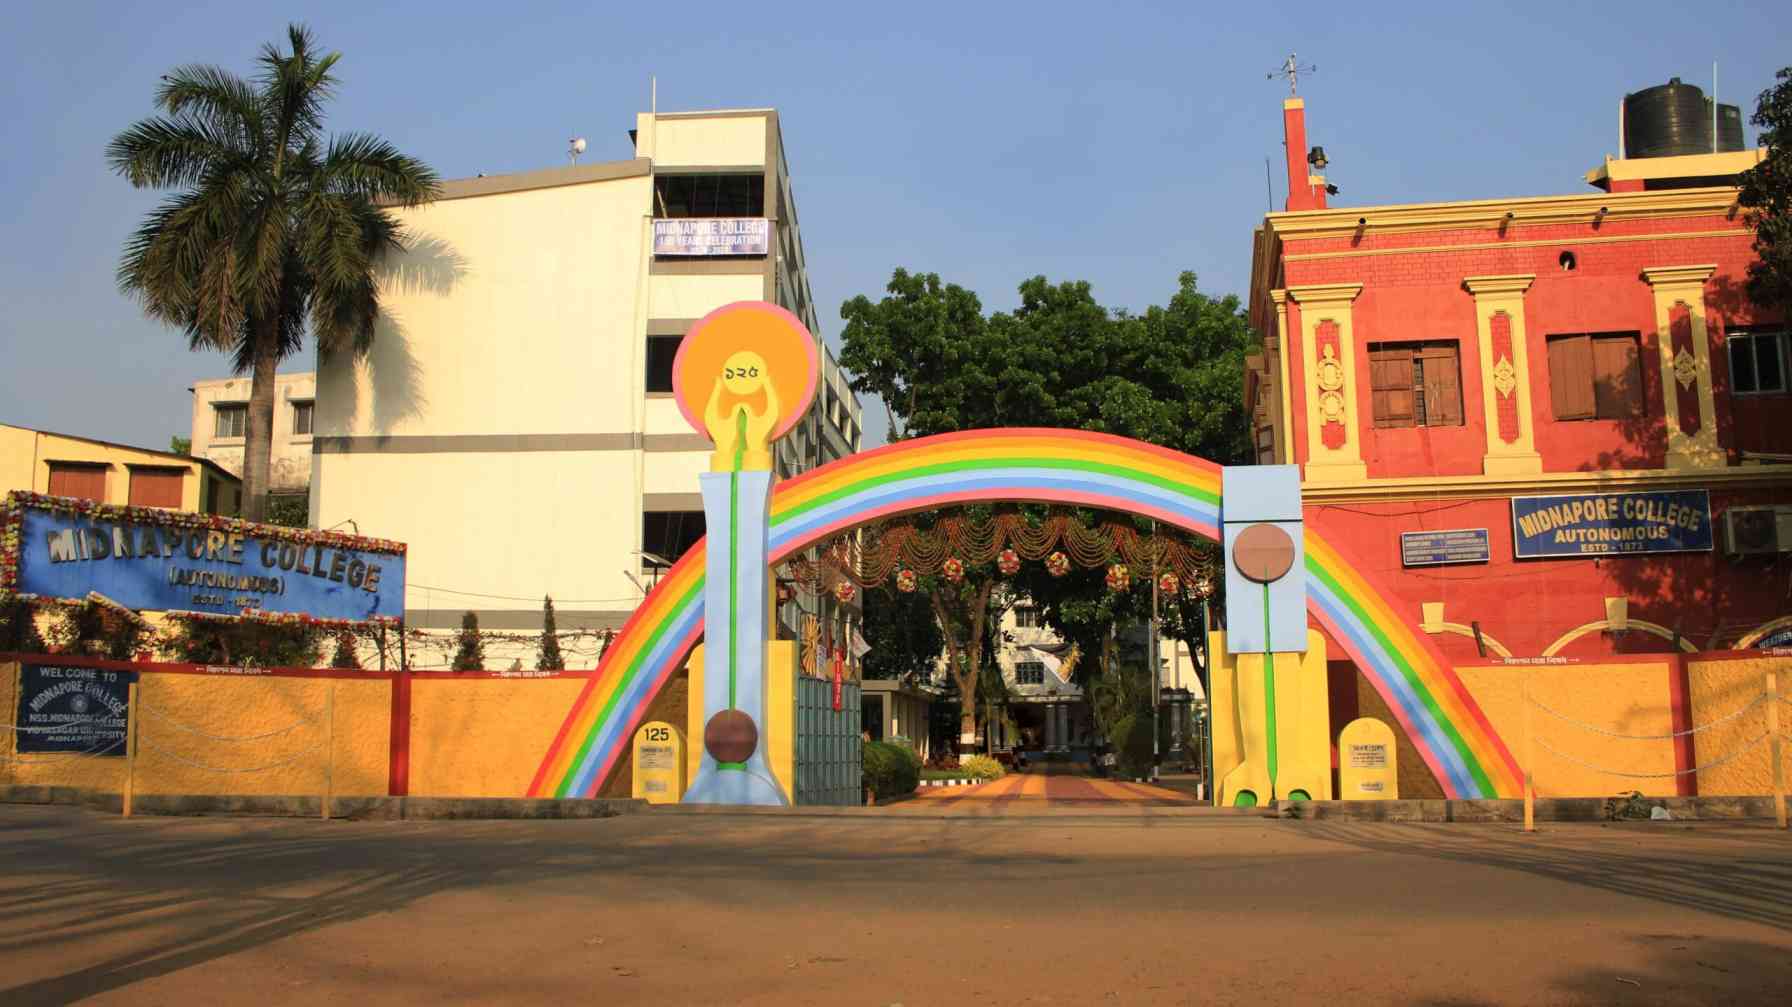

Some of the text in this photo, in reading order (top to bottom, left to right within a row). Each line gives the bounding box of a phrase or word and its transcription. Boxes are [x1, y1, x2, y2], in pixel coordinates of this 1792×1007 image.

[1519, 498, 1702, 538] MIDNAPORE COLLEGE
[1555, 526, 1669, 543] AUTONOMOUS
[1581, 543, 1608, 552] ESTD
[48, 527, 382, 592] MIDNAPORE COLLEGE
[169, 566, 285, 596] (AUTONOMOUS)
[103, 672, 117, 682] TO
[30, 681, 83, 712] MIDNAPORE
[645, 728, 669, 741] 125
